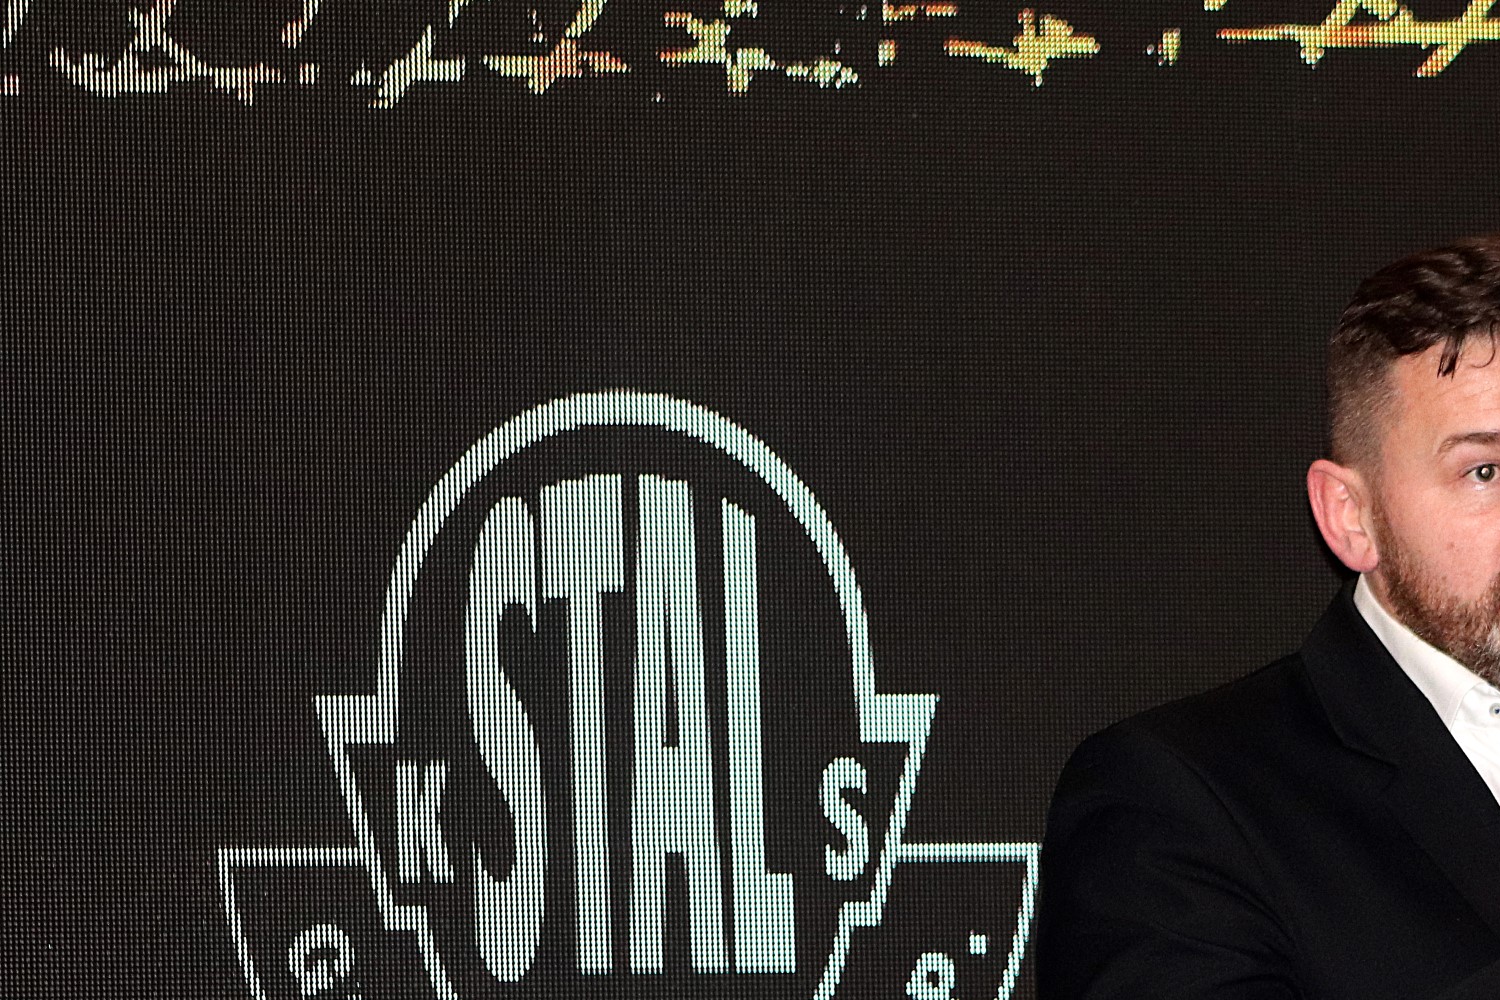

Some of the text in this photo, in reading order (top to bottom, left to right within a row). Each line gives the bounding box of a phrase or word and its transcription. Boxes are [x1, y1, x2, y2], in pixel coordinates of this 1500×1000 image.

[396, 473, 870, 982] K STAL S
